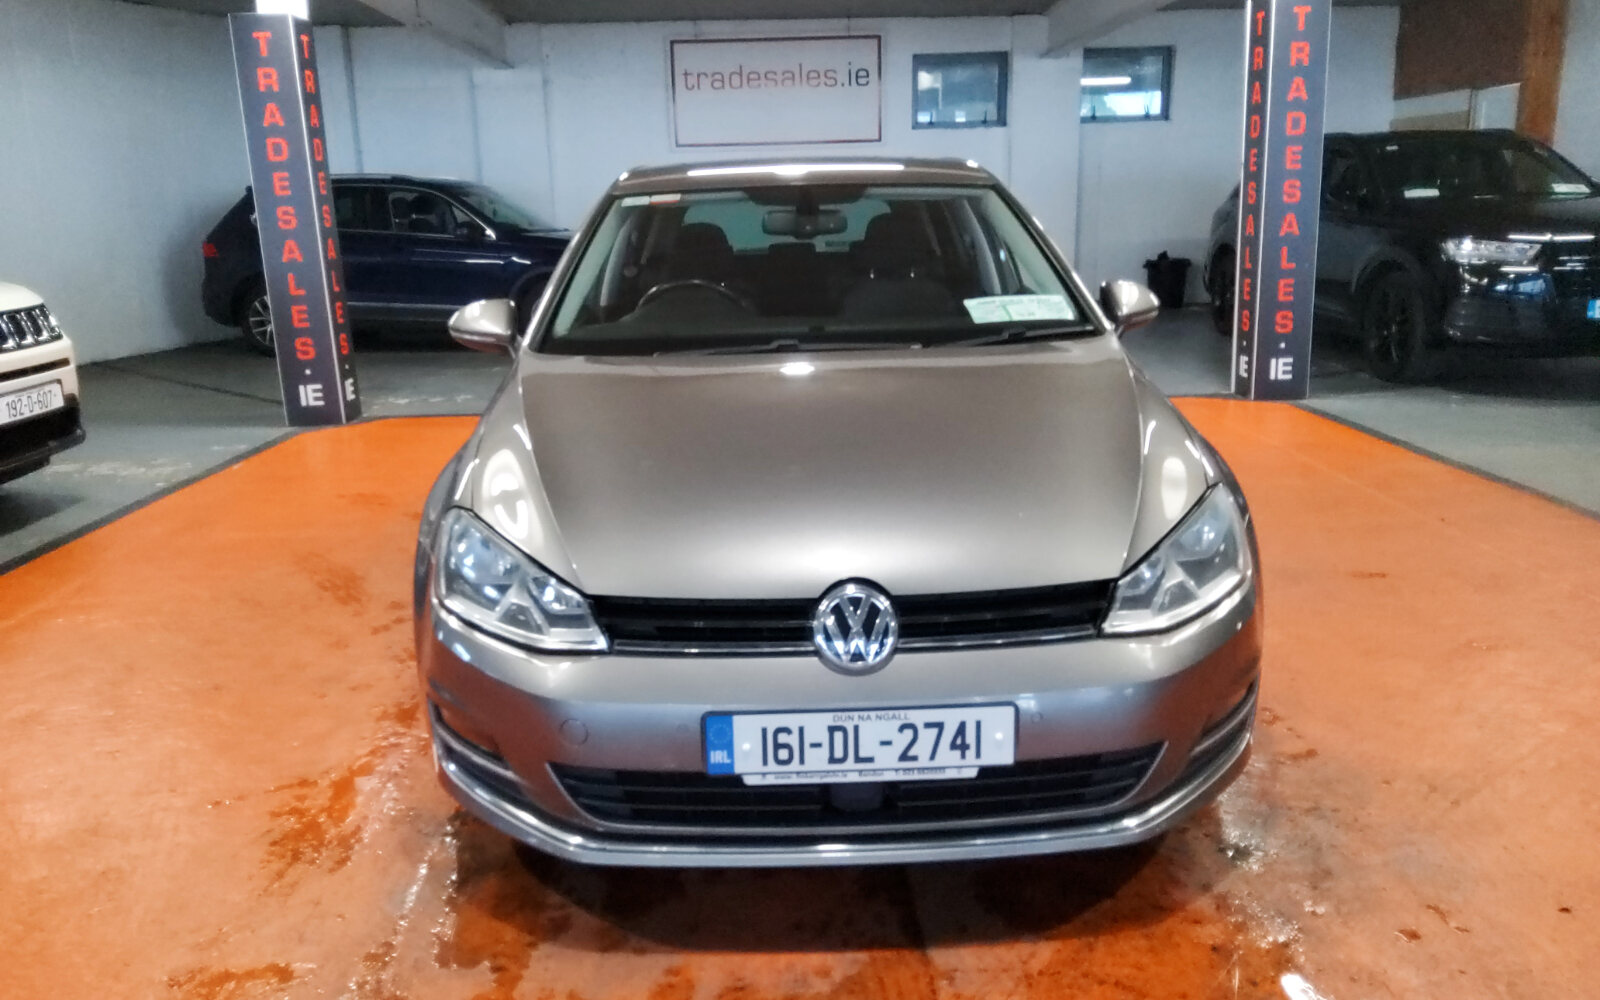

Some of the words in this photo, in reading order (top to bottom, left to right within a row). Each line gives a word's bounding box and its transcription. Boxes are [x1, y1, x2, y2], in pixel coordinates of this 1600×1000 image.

[682, 61, 870, 91] tradesales.ie
[6, 390, 52, 418] 192-D-607
[820, 590, 892, 665] VW
[857, 713, 872, 721] NA
[710, 751, 731, 763] IRL
[761, 720, 982, 766] 161-DL-2741
